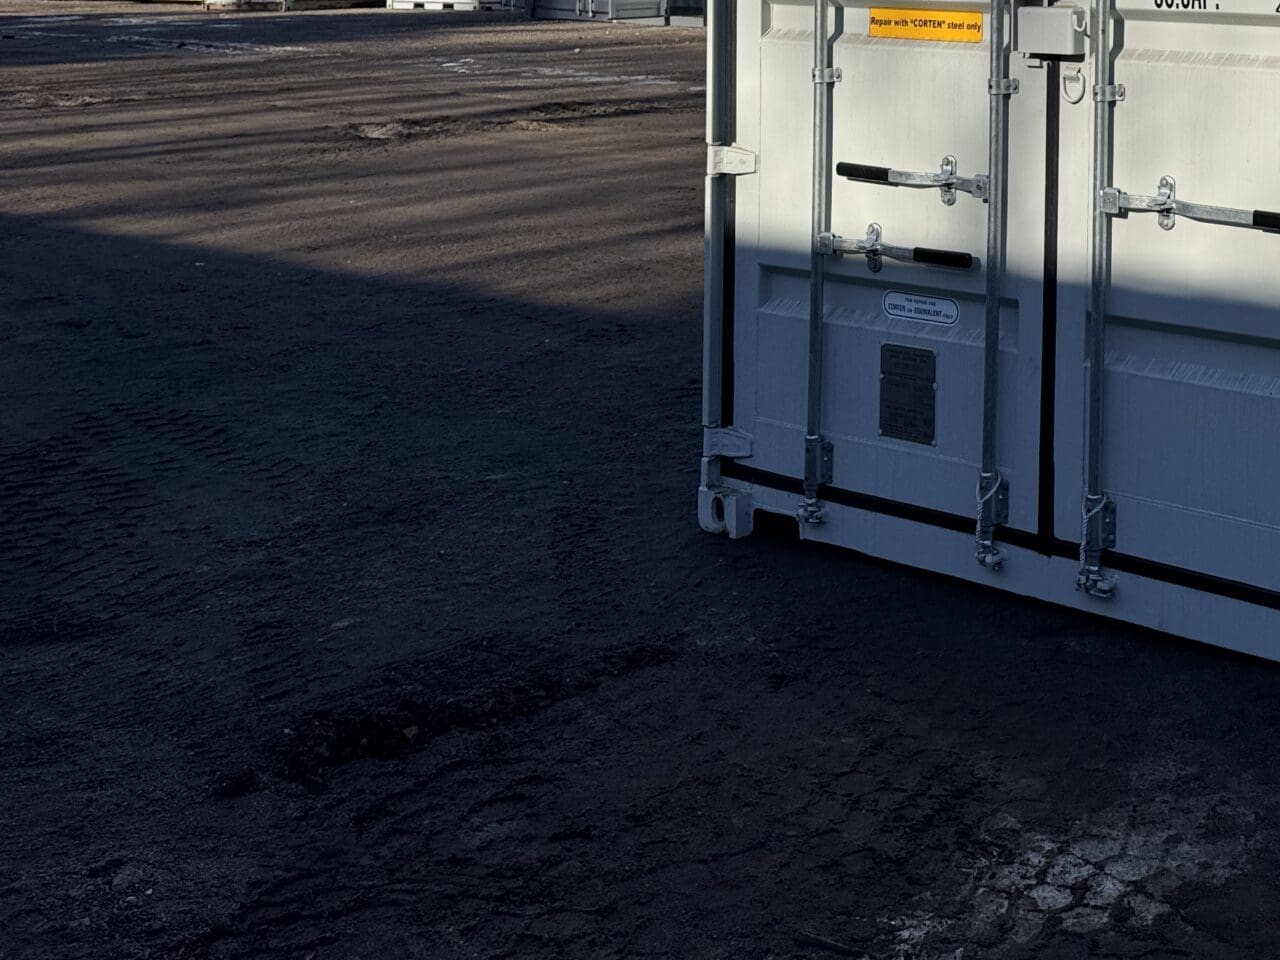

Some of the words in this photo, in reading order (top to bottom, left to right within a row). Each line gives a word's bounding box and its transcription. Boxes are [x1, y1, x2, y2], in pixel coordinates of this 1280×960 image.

[870, 16, 892, 28] Repair
[894, 19, 908, 27] with
[947, 21, 965, 30] steel
[966, 22, 981, 33] only
[914, 306, 942, 318] EQUIVALENT
